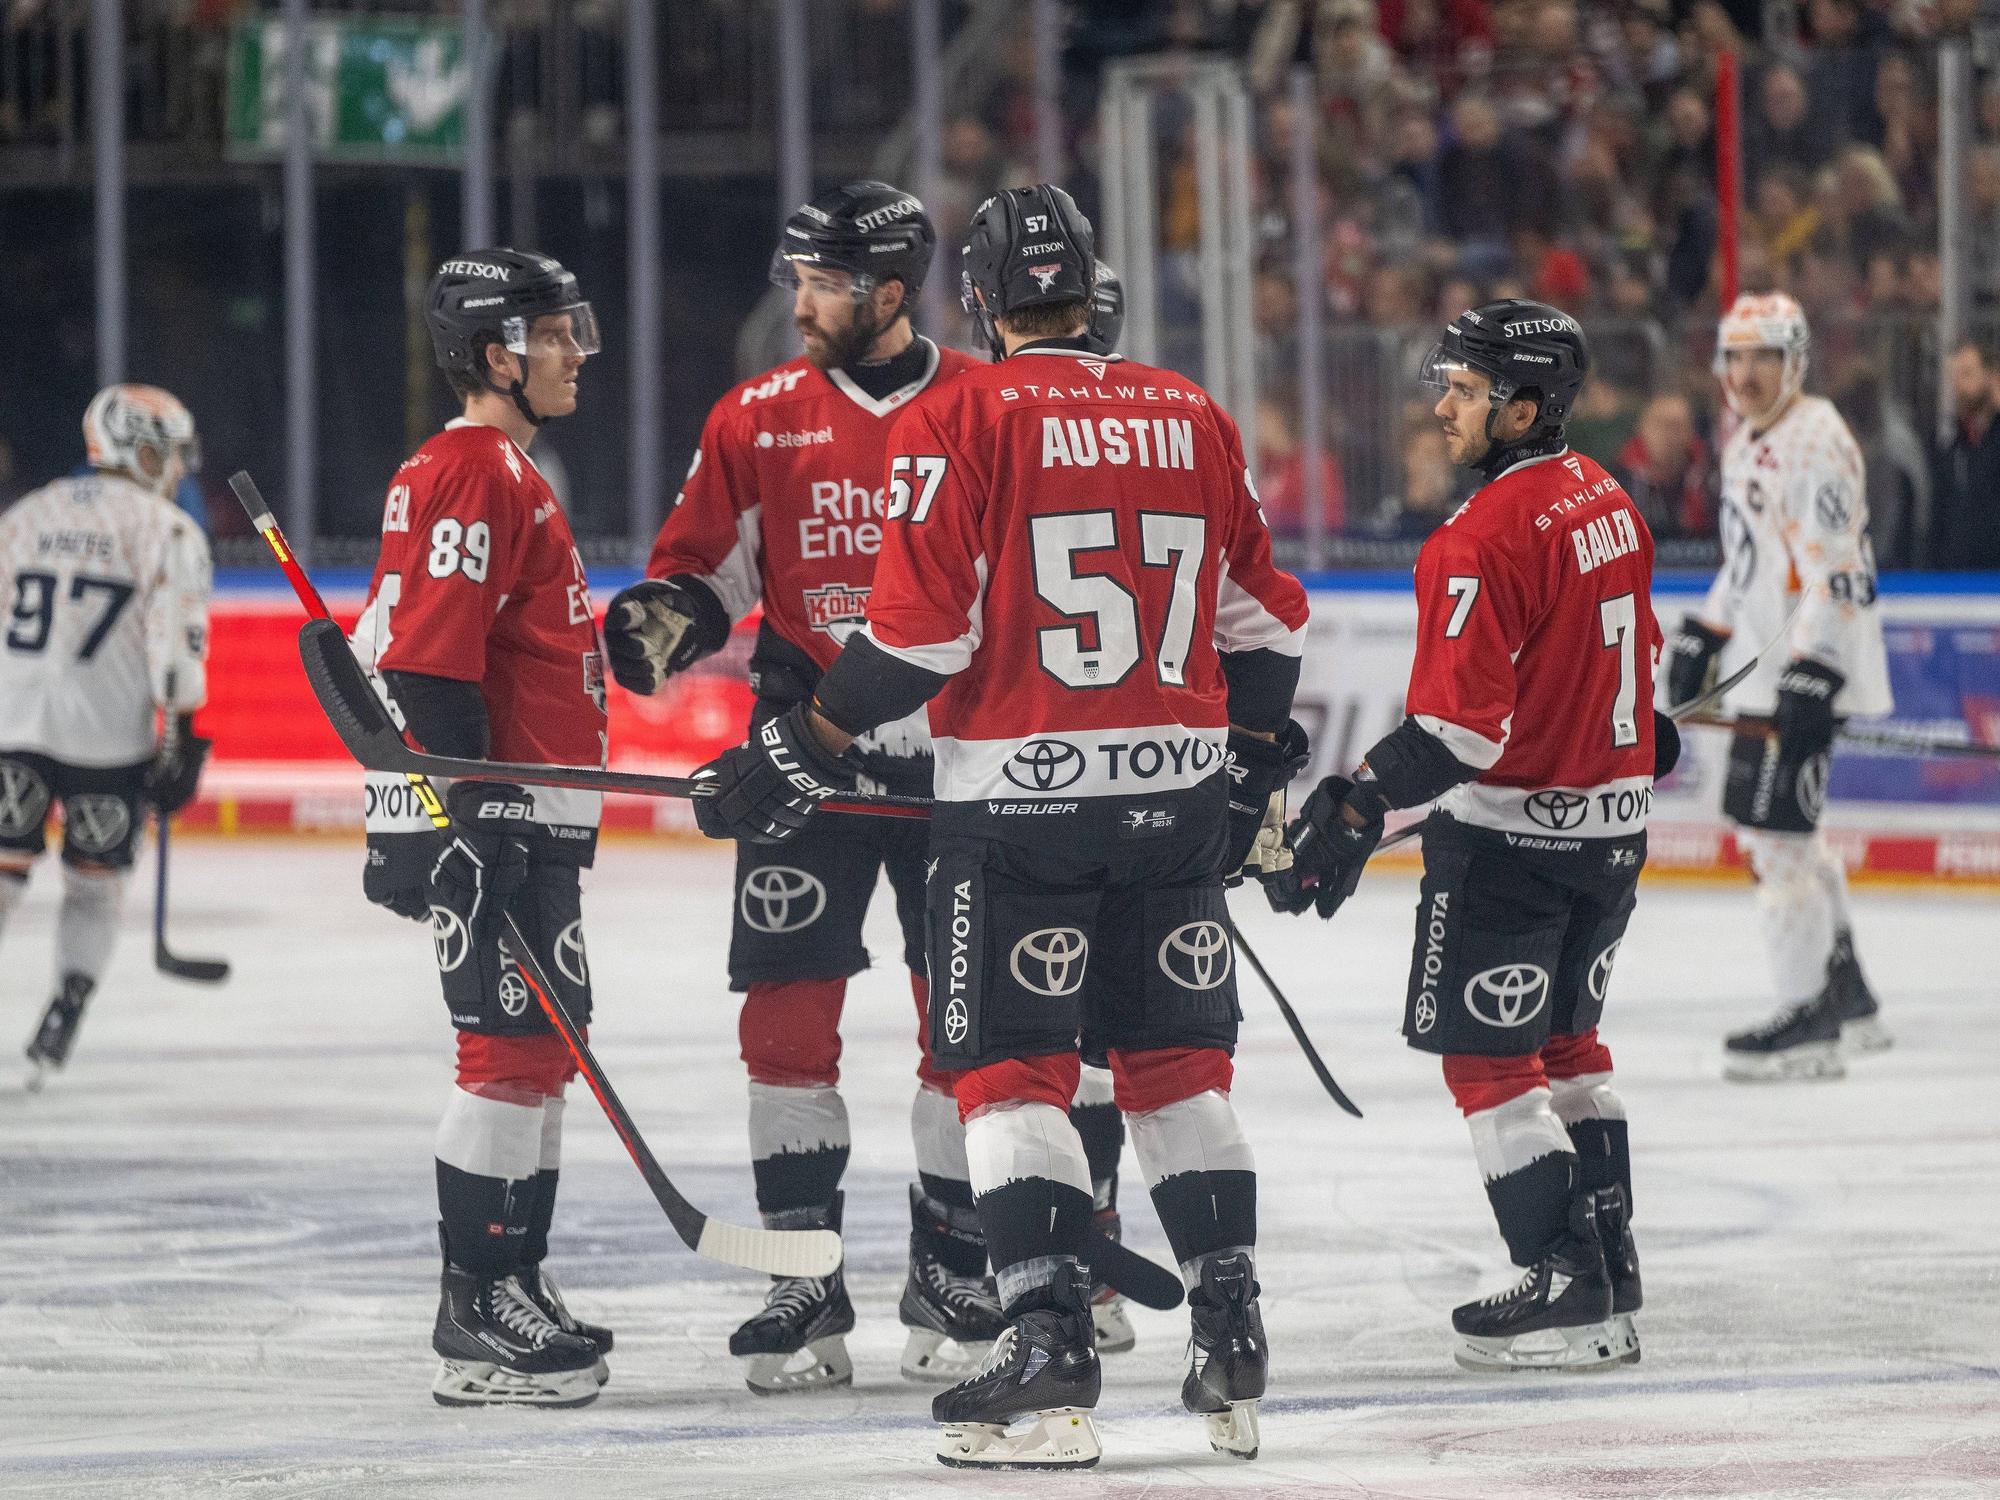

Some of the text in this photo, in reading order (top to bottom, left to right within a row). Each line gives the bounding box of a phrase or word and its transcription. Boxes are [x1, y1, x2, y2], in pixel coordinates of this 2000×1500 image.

[854, 197, 925, 234] STETSON
[1025, 215, 1048, 233] 57
[1022, 241, 1065, 257] STETSON
[438, 260, 510, 282] STETSON
[1503, 318, 1576, 338] STETSON
[1513, 353, 1553, 365] BAUER
[1000, 385, 1201, 406] STAHLWERK
[776, 426, 833, 448] steinel
[1042, 416, 1195, 471] AUSTIN
[886, 455, 949, 525] 57
[427, 517, 490, 584] 89
[1571, 508, 1639, 575] BAILEN
[8, 570, 135, 661] 97
[1027, 508, 1206, 691] 57
[1445, 576, 1480, 639] 7
[1600, 591, 1637, 749] 7
[1098, 736, 1221, 781] TOYO
[1001, 802, 1079, 816] BAUER
[1152, 810, 1166, 818] HOME
[1152, 819, 1172, 828] 2023-24
[1518, 836, 1583, 852] BAUER
[950, 879, 972, 995] TOYOTA
[1423, 891, 1449, 989] TOYOTA
[477, 1331, 517, 1362] BAUER
